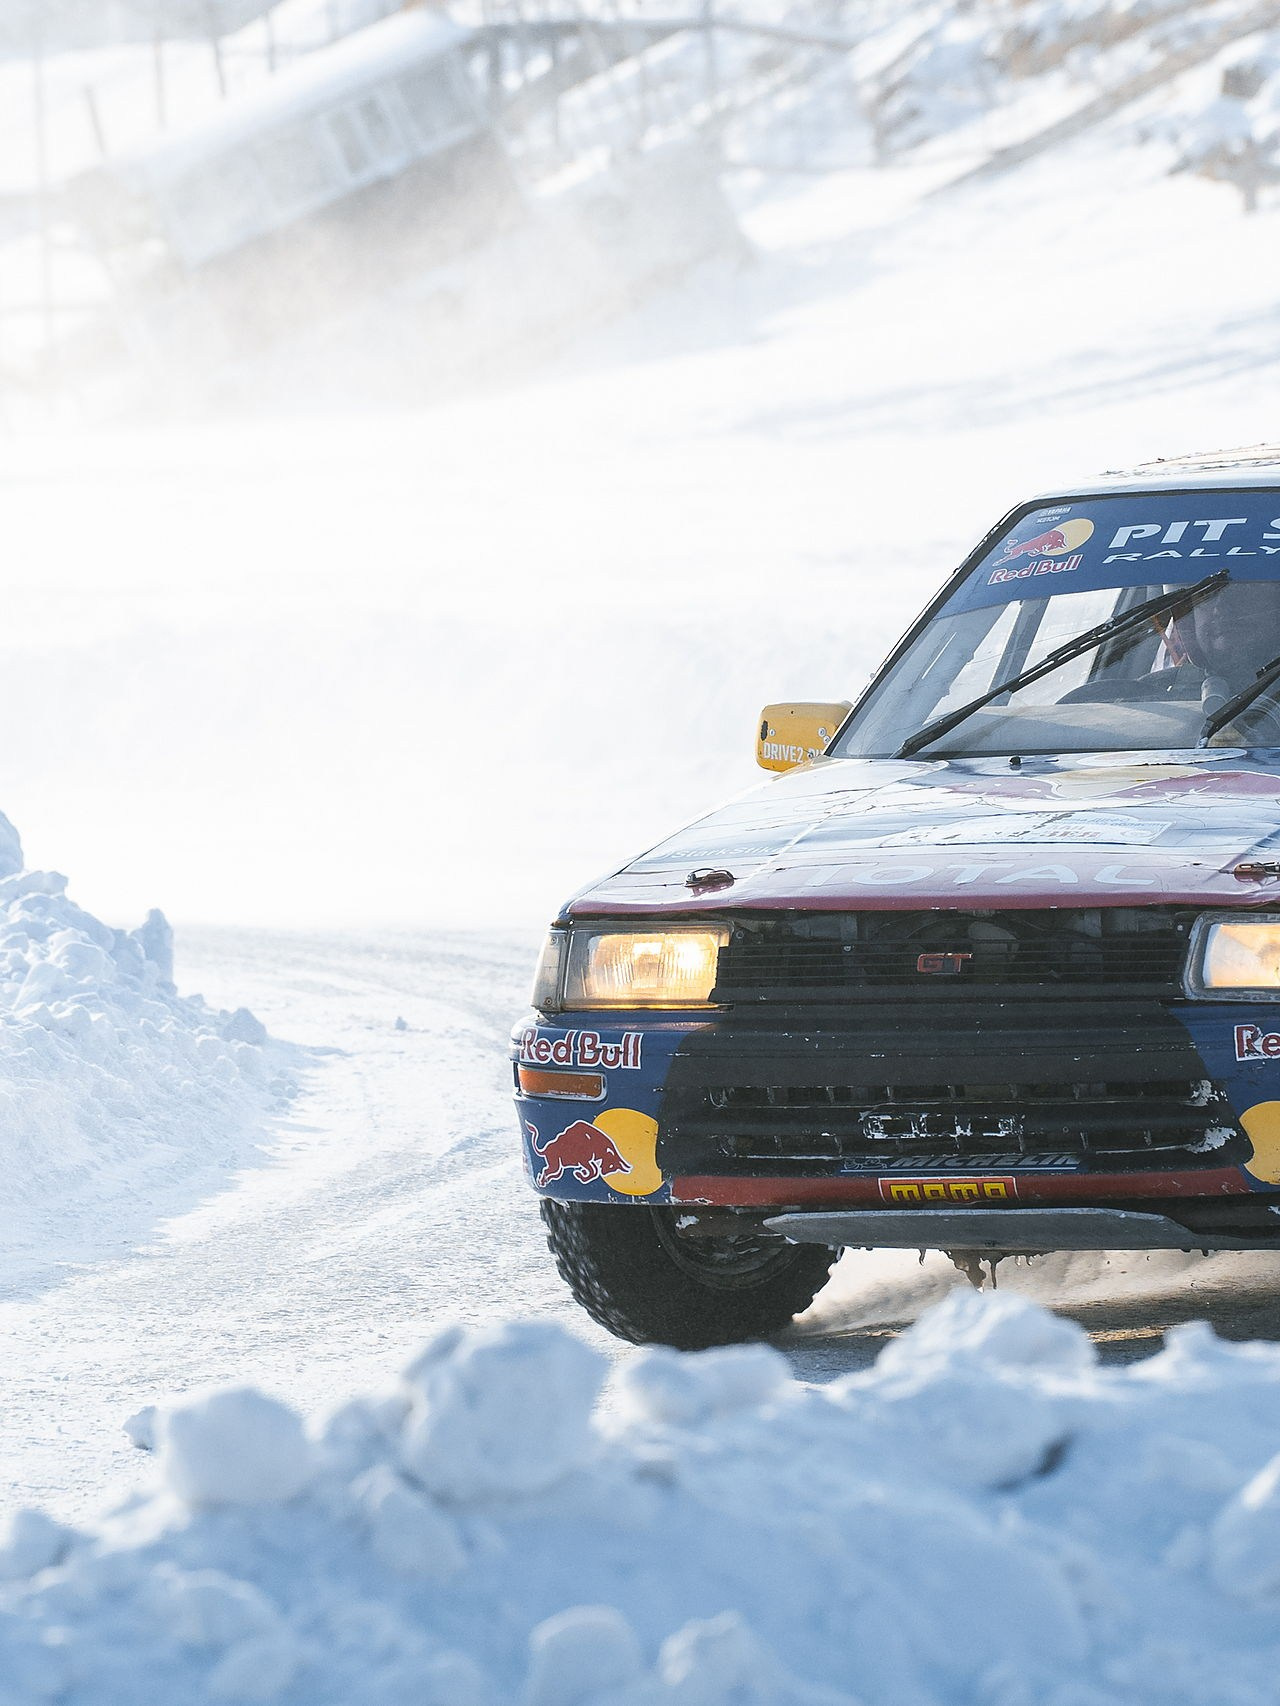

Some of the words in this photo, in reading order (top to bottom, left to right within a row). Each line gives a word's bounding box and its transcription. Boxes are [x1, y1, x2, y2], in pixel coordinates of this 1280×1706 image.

[1108, 518, 1248, 549] PIT
[987, 562, 1034, 585] Red
[1033, 554, 1083, 577] Bull
[763, 742, 824, 763] DRIVE2R
[799, 864, 1156, 887] TOTAL
[917, 953, 973, 974] GT
[519, 1027, 577, 1066] Red
[577, 1032, 644, 1069] Bull
[890, 1155, 1081, 1167] MICHELIN
